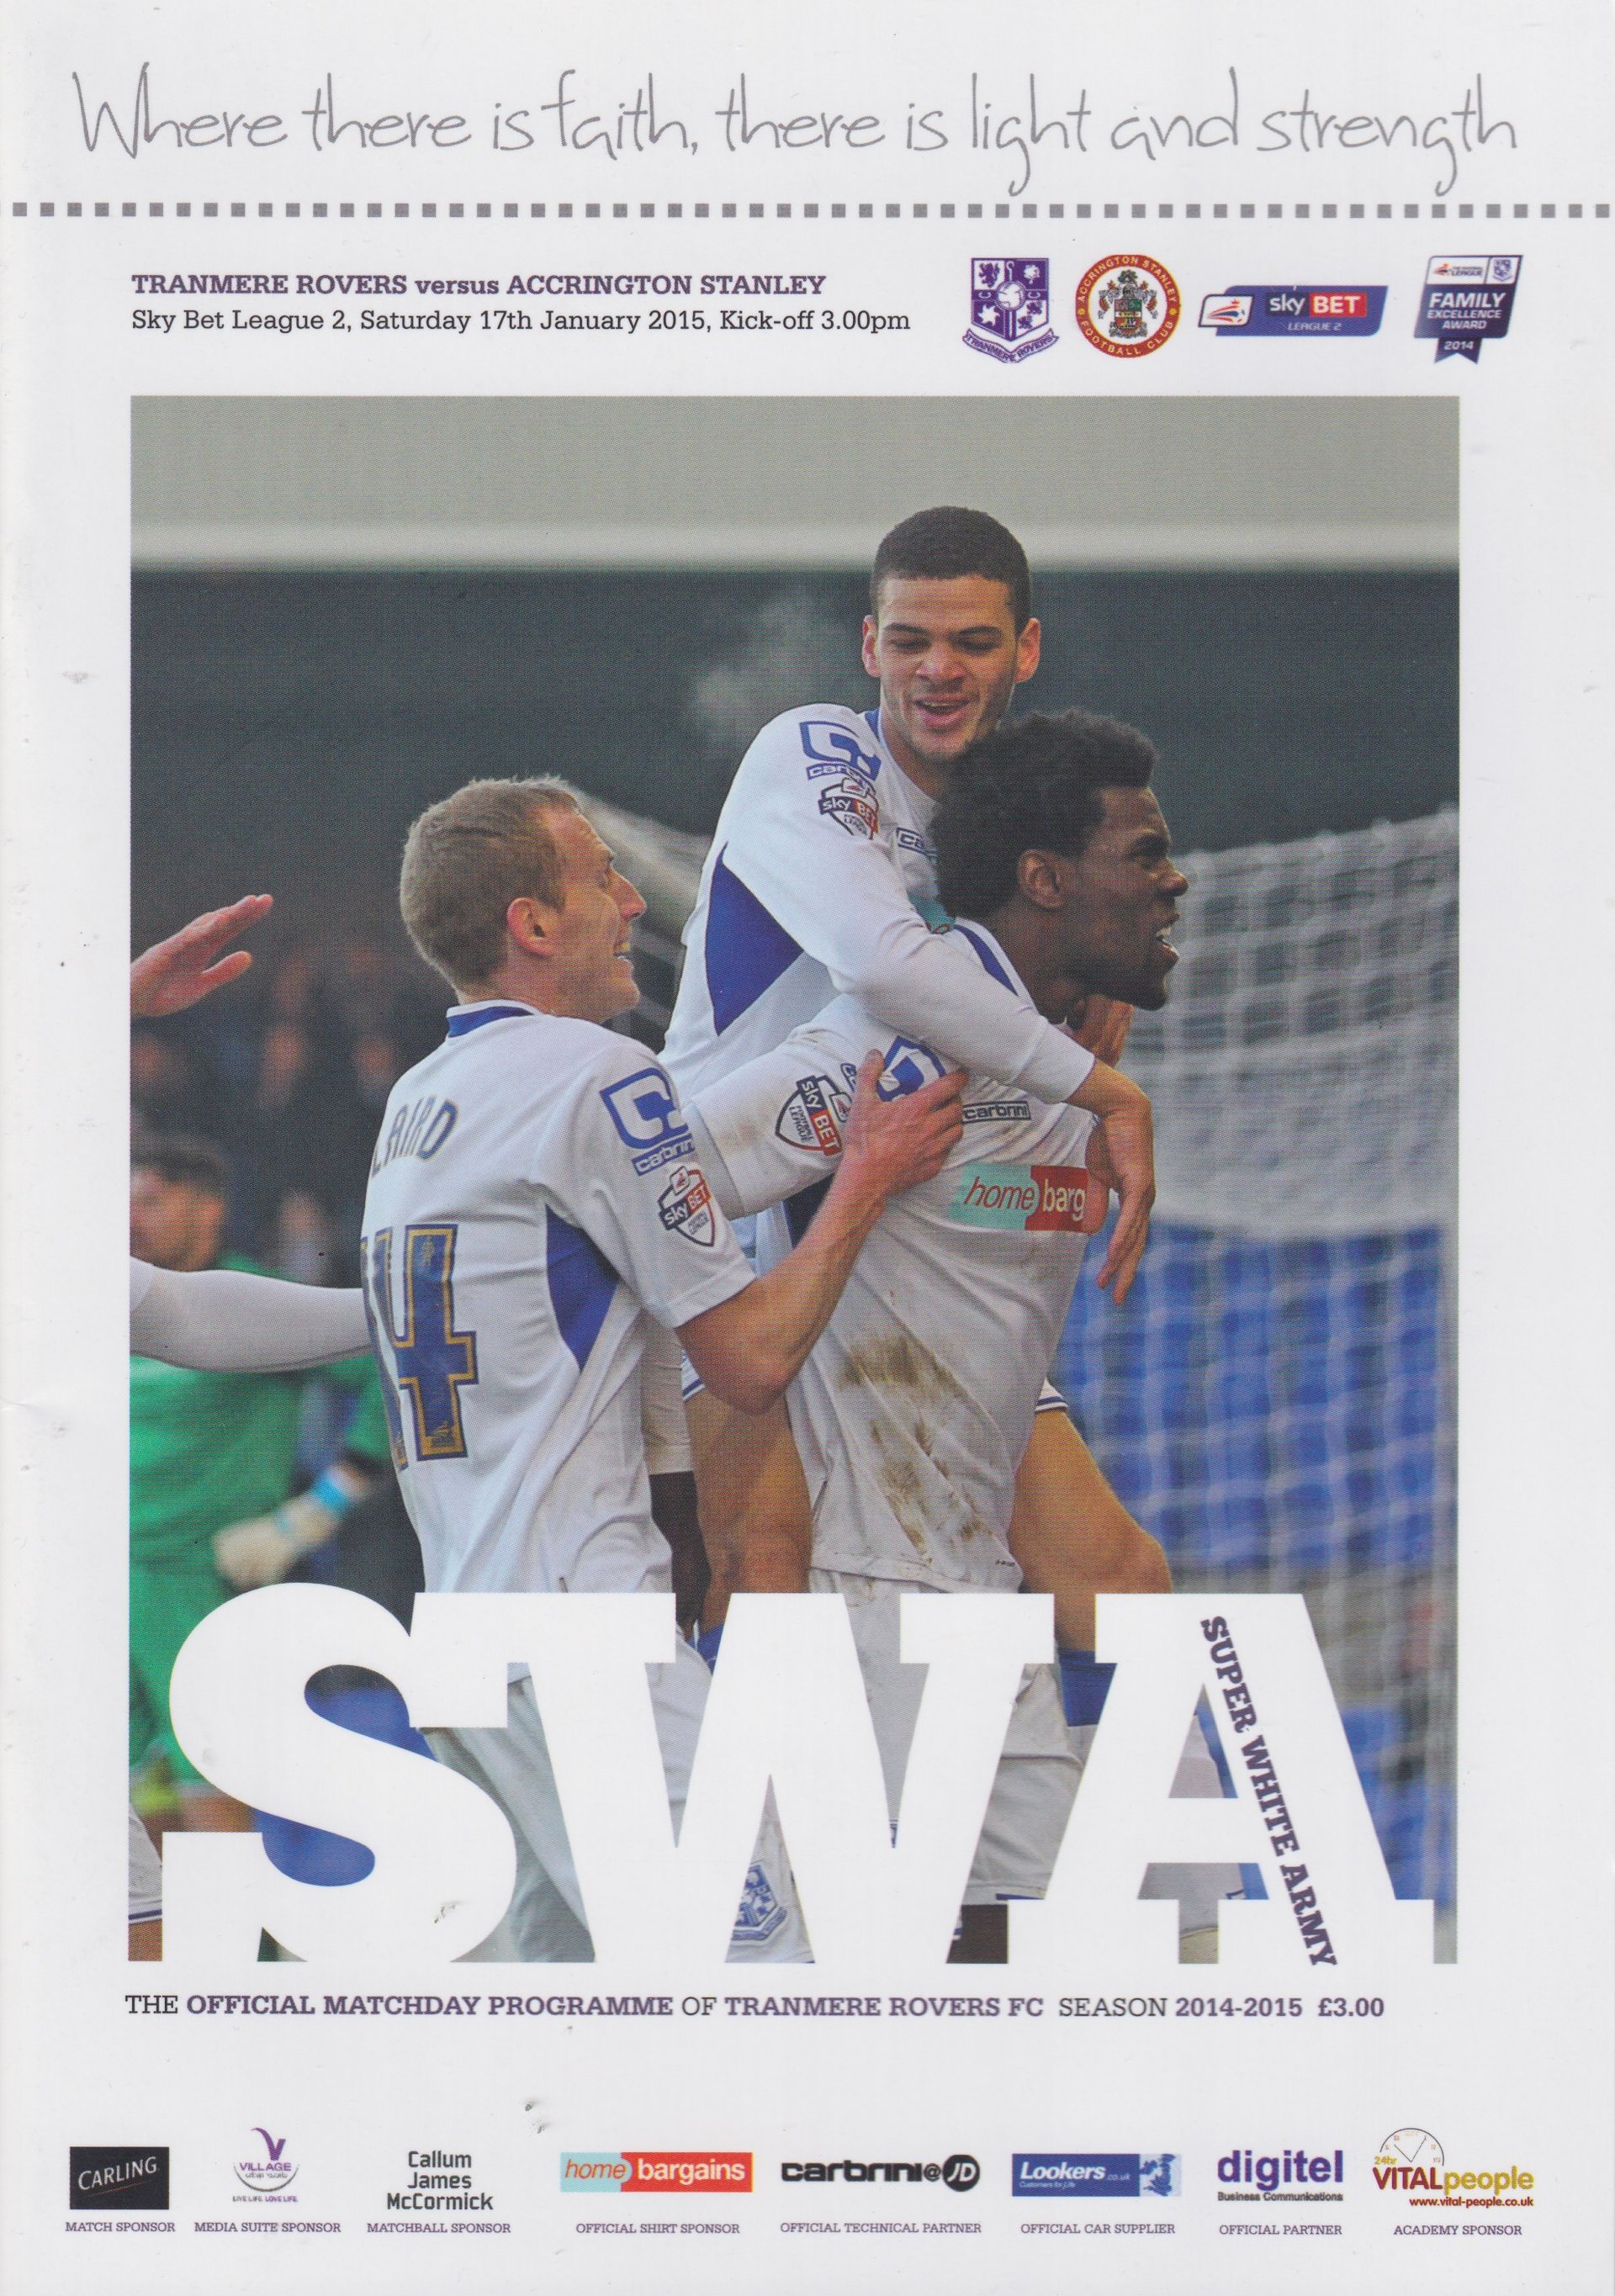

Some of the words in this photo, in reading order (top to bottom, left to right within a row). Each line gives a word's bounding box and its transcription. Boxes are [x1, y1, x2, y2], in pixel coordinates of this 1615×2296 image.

[72, 62, 288, 158] Where
[303, 73, 472, 151] there
[493, 102, 535, 151] is
[541, 70, 698, 160] faith,
[715, 73, 885, 151] there
[907, 103, 948, 151] is
[972, 73, 1091, 196] light
[1110, 66, 1239, 160] and
[1258, 73, 1517, 196] strength
[131, 274, 289, 294] TRANMERE
[296, 274, 407, 295] ROVERS
[415, 279, 499, 295] versus
[506, 274, 692, 295] ACCRINGTON
[701, 274, 826, 295] STANLEY
[1078, 256, 1138, 303] ACCRINGTON
[1142, 260, 1177, 303] STANLEY
[1269, 294, 1305, 315] sky
[1313, 295, 1361, 314] BET
[1429, 292, 1506, 308] FAMILY
[132, 309, 176, 334] Sky
[183, 309, 224, 330] Bet
[232, 309, 324, 334] League
[332, 309, 351, 333] 2,
[361, 309, 471, 335] Saturday
[481, 309, 532, 331] 17th
[540, 309, 641, 335] January
[649, 309, 711, 333] 2015,
[720, 309, 815, 331] Kick-off
[822, 309, 910, 335] 3.00pm
[1427, 309, 1502, 319] EXCELLENCE
[1288, 322, 1331, 331] LEAGUE
[1442, 320, 1487, 329] AWARD
[1081, 320, 1141, 355] FOOTBALL
[1146, 321, 1173, 346] CLUB
[1444, 341, 1475, 350] 2014
[964, 1176, 1035, 1211] home
[162, 1582, 1434, 1963] SWA
[1200, 1615, 1258, 1734] SUPER
[1241, 1734, 1300, 1857] WHITE
[1279, 1863, 1337, 1966] ARMY
[125, 1994, 178, 2014] THE
[187, 1994, 315, 2015] OFFICIAL
[323, 1995, 481, 2016] MATCHDAY
[488, 1996, 673, 2016] PROGRAMME
[682, 1997, 717, 2017] OF
[724, 1997, 881, 2017] TRANMERE
[889, 1997, 1000, 2018] ROVERS
[1008, 1997, 1043, 2018] FC
[1059, 1997, 1168, 2018] SEASON
[1176, 1997, 1302, 2018] 2014-2015
[1318, 1997, 1385, 2018] £3.00
[239, 2162, 291, 2172] VILLAGE
[408, 2150, 472, 2169] Callum
[77, 2156, 158, 2191] CARLING
[564, 2159, 626, 2179] home
[638, 2158, 745, 2185] bargains
[1217, 2150, 1344, 2191] digitel
[407, 2171, 472, 2190] James
[386, 2192, 494, 2211] McCormick
[1217, 2192, 1262, 2201] Business
[1263, 2192, 1344, 2201] Communications
[1409, 2196, 1534, 2209] www.vital-people.co.uk
[65, 2221, 113, 2232] MATCH
[115, 2221, 176, 2233] SPONSOR
[193, 2221, 239, 2233] MEDIA
[241, 2222, 278, 2233] SUITE
[281, 2221, 342, 2233] SPONSOR
[367, 2222, 448, 2234] MATCHBALL
[450, 2222, 511, 2234] SPONSOR
[575, 2223, 638, 2234] OFFICIAL
[639, 2223, 678, 2234] SHIRT
[680, 2223, 740, 2234] SPONSOR
[780, 2222, 841, 2233] OFFICIAL
[844, 2222, 919, 2234] TECHNICAL
[922, 2222, 982, 2234] PARTNER
[1020, 2223, 1082, 2235] OFFICIAL
[1083, 2223, 1112, 2235] CAR
[1114, 2223, 1176, 2235] SUPPLIER
[1219, 2225, 1280, 2235] OFFICIAL
[1282, 2225, 1343, 2235] PARTNER
[1393, 2225, 1459, 2235] ACADEMY
[1462, 2225, 1522, 2235] SPONSOR
